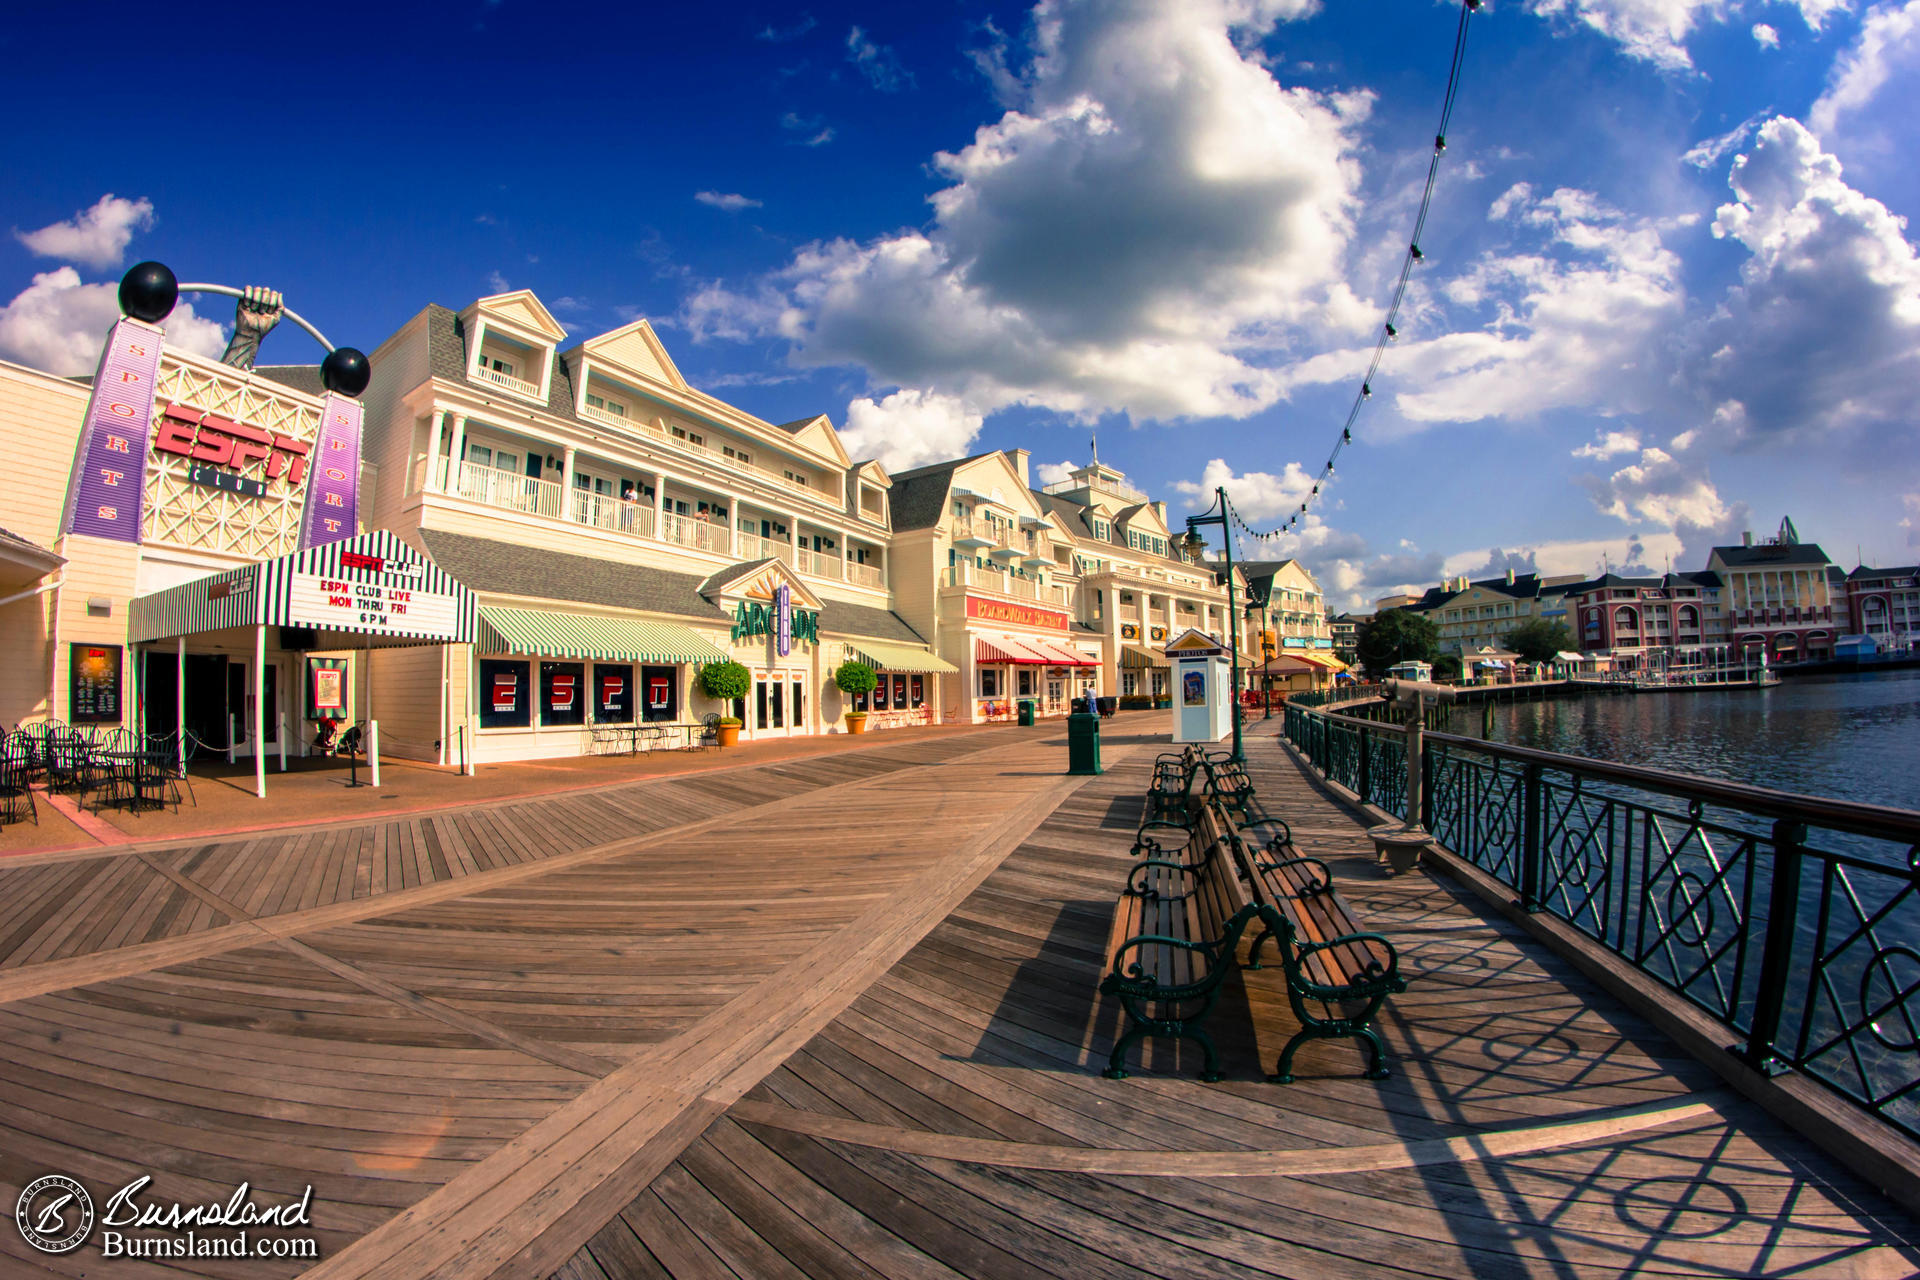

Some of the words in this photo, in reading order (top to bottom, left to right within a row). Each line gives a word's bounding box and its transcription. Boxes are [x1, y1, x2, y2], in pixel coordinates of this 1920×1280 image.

[97, 344, 146, 520] SPORTS
[154, 403, 310, 485] ESPN
[192, 468, 265, 496] CLUB
[341, 551, 383, 572] ESPN
[382, 559, 423, 578] CLUB
[320, 580, 349, 593] ESPN
[355, 585, 382, 598] CLUB
[388, 590, 411, 602] LIVE
[329, 595, 352, 608] MON
[357, 598, 384, 611] THRU
[391, 602, 407, 614] FRI
[731, 600, 820, 645] ARCADE
